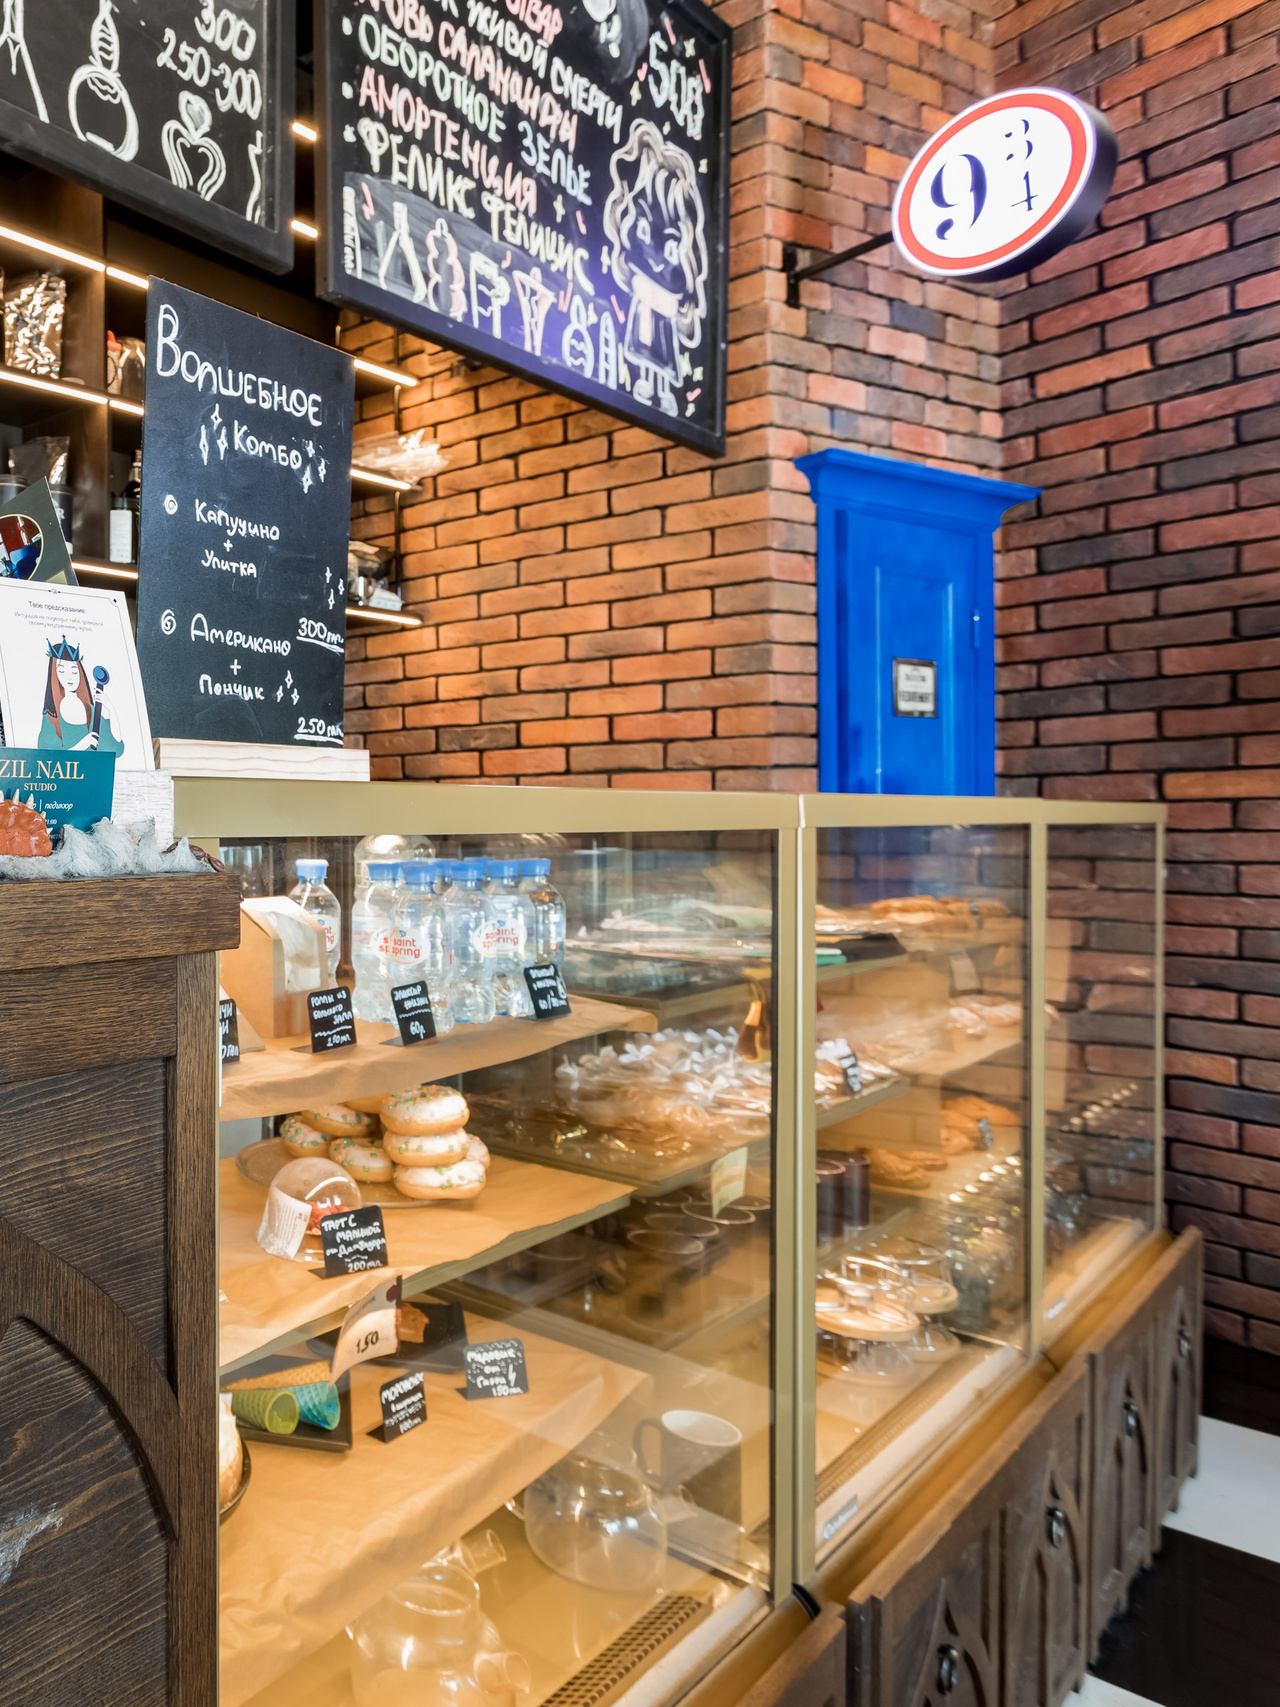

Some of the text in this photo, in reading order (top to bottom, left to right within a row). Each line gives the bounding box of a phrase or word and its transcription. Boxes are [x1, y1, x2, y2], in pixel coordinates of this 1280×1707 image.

[194, 0, 256, 60] 300
[358, 14, 592, 206] ОБОРОТНОЕ ЗЕЛЬЕ
[359, 64, 538, 218] АМОРТЕНЦИЯ
[357, 116, 476, 220] ФЕЛИКС
[23, 782, 58, 792] STUDIO
[36, 760, 85, 780] NAIL
[321, 1216, 348, 1232] ТАРТ
[356, 1330, 379, 1354] 150
